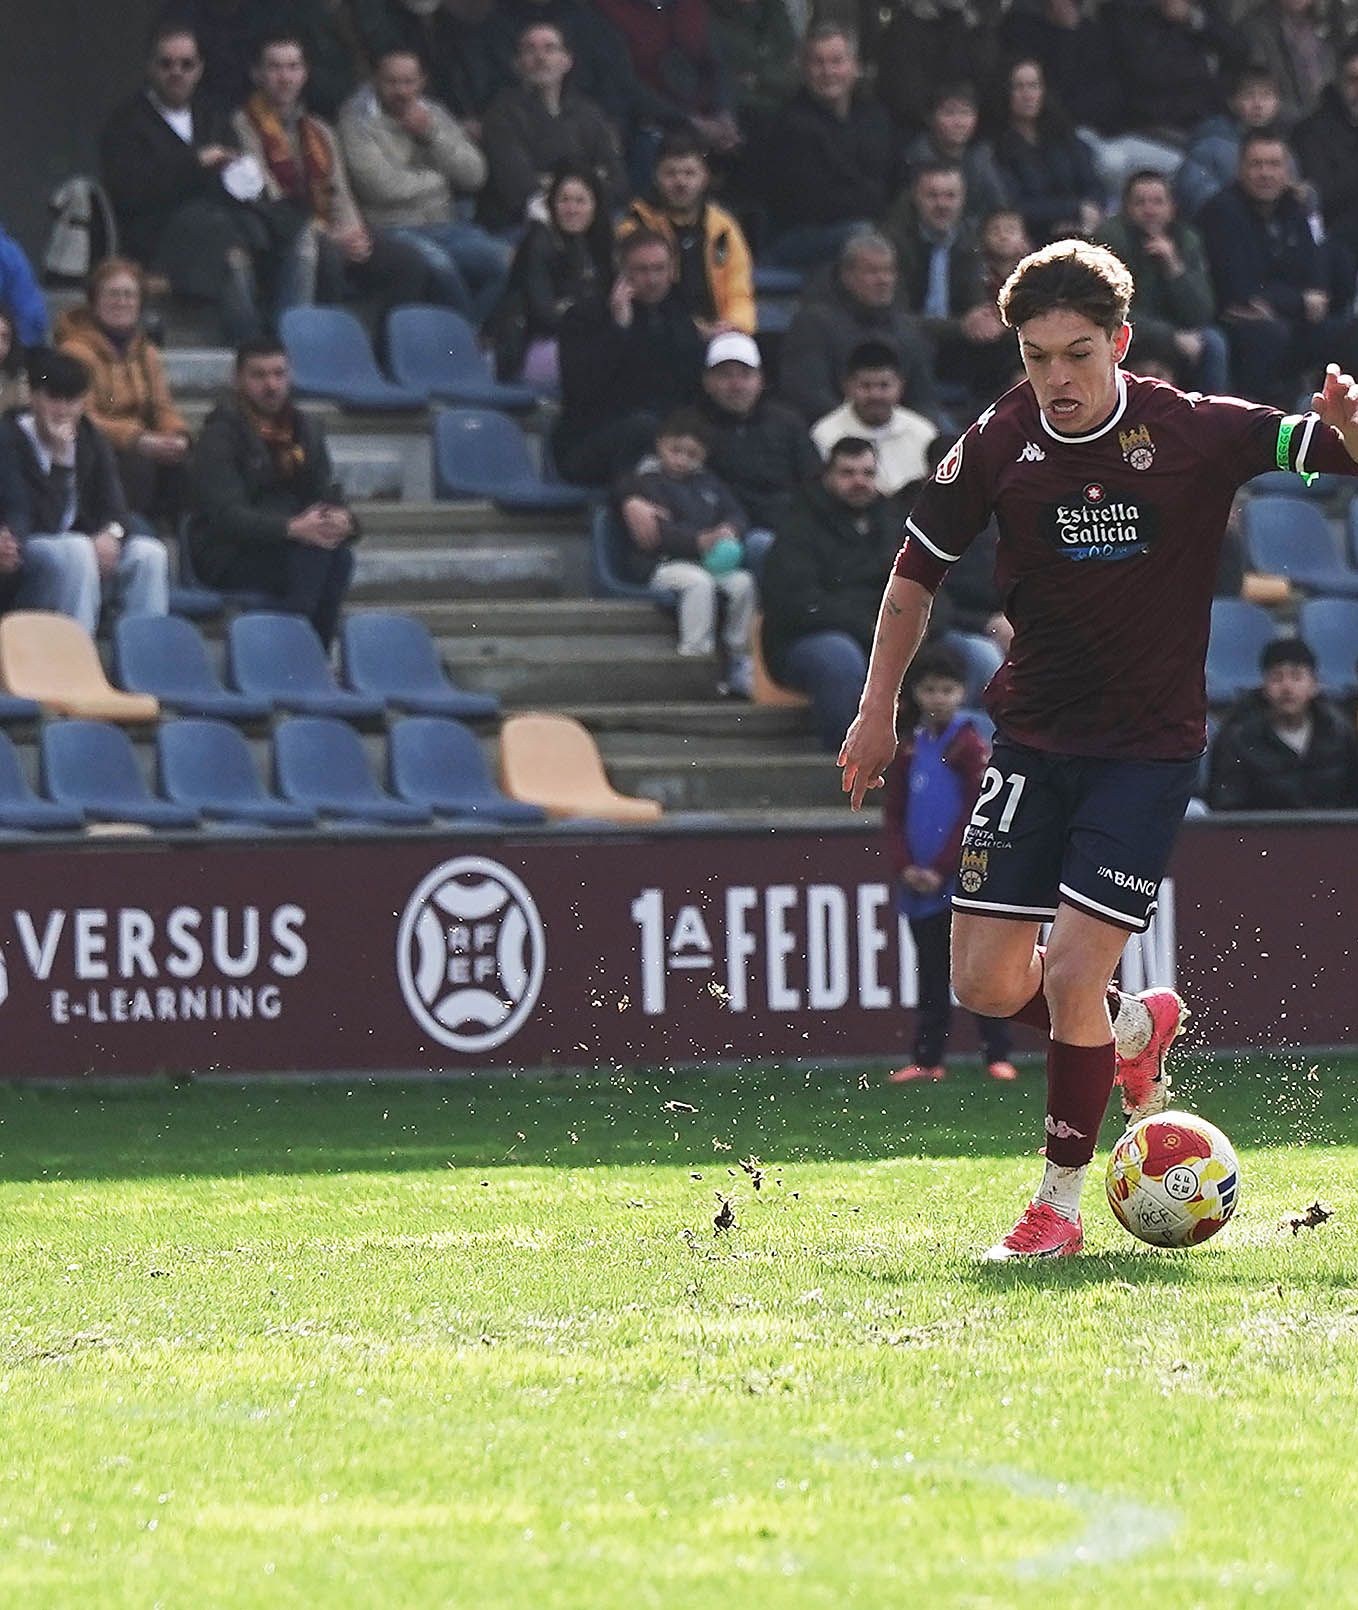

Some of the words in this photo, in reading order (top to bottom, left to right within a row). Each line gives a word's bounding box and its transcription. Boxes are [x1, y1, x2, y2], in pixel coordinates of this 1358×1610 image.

[1056, 503, 1139, 524] Estrella
[1061, 522, 1138, 544] Galicia
[969, 766, 1026, 833] 21
[13, 904, 308, 980] VERSUS
[51, 984, 282, 1024] E-LEARNING
